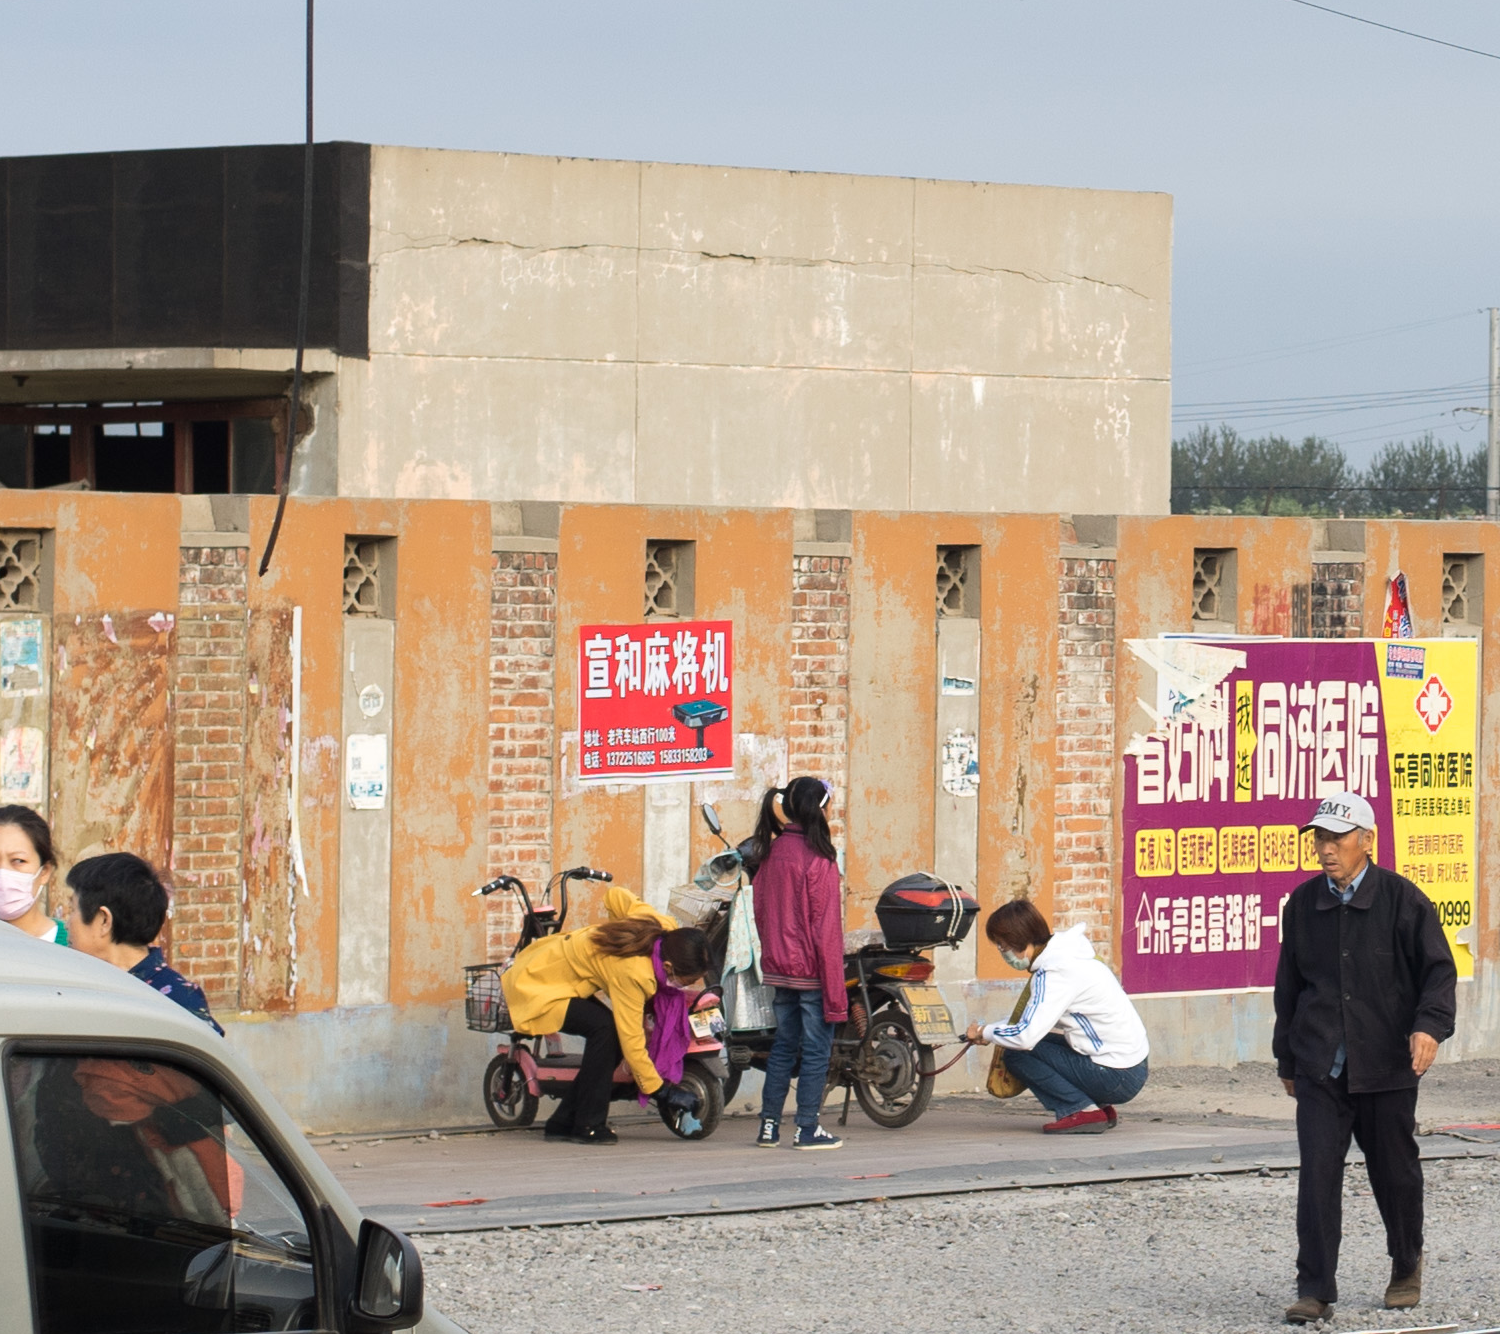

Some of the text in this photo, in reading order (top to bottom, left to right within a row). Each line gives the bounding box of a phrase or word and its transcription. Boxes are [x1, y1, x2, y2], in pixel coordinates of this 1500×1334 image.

[584, 629, 729, 699] 宣和麻将机
[1256, 679, 1379, 801] 同济医院
[1393, 752, 1473, 789] 乐亭同济医院
[1396, 797, 1471, 817] 职工/居民医保定点单位
[1138, 836, 1172, 871] 无痛人流
[1222, 832, 1256, 867] 乳腺疾病
[1262, 830, 1296, 866] 妇科炎症
[1408, 834, 1464, 857] 我信赖同济医院
[1154, 893, 1290, 955] 乐亭县富强街一
